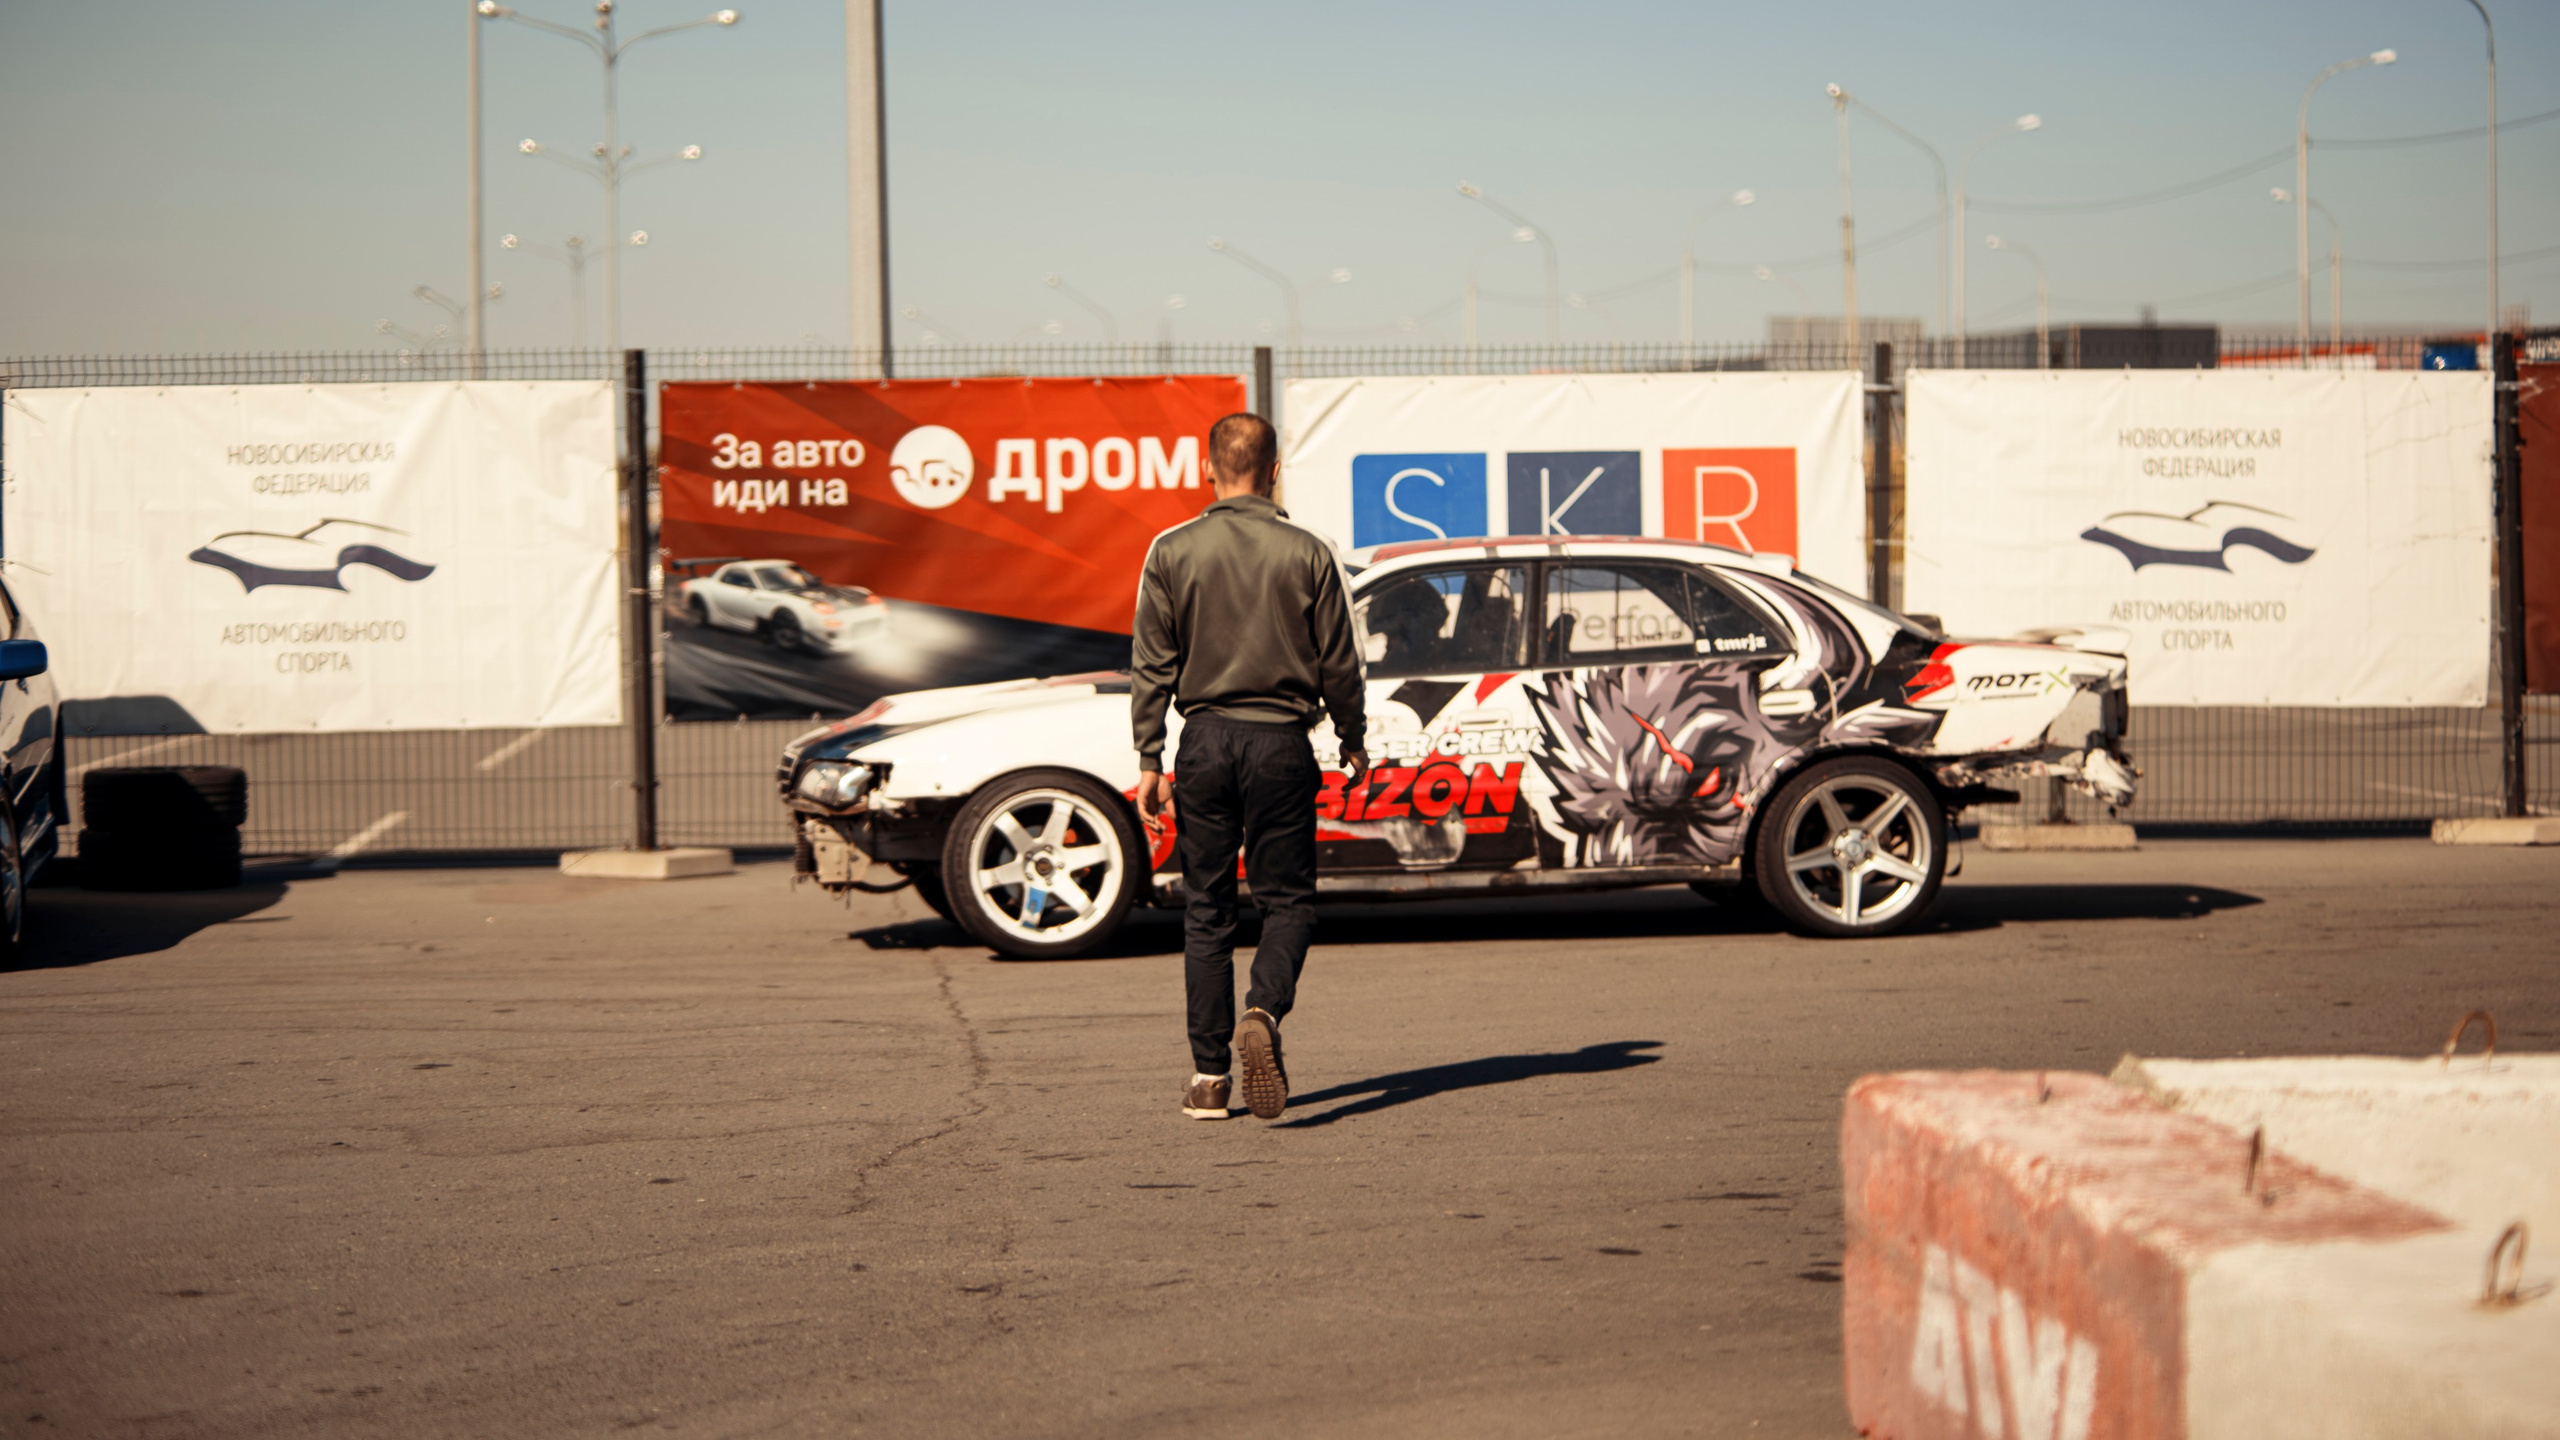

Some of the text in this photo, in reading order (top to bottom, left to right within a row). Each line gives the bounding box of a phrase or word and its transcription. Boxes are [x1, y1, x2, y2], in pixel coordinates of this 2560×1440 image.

[711, 432, 866, 469] За авто
[2118, 428, 2283, 449] НОВОСИБИРСКАЯ
[226, 441, 397, 465] НОВОСИБИРСКАЯ
[988, 435, 1201, 514] дром
[2142, 456, 2257, 479] ФЕДЕРАЦИЯ
[252, 471, 371, 496] ФЕДЕРАЦИЯ
[712, 477, 849, 514] иди на
[2109, 600, 2288, 623] АВТОМОБИЛЬНОГО
[220, 619, 407, 645] АВТОМОБИЛЬНОГО
[2161, 628, 2234, 651] СПОРТА
[276, 650, 352, 674] СПОРТА
[1435, 727, 1540, 757] CREW
